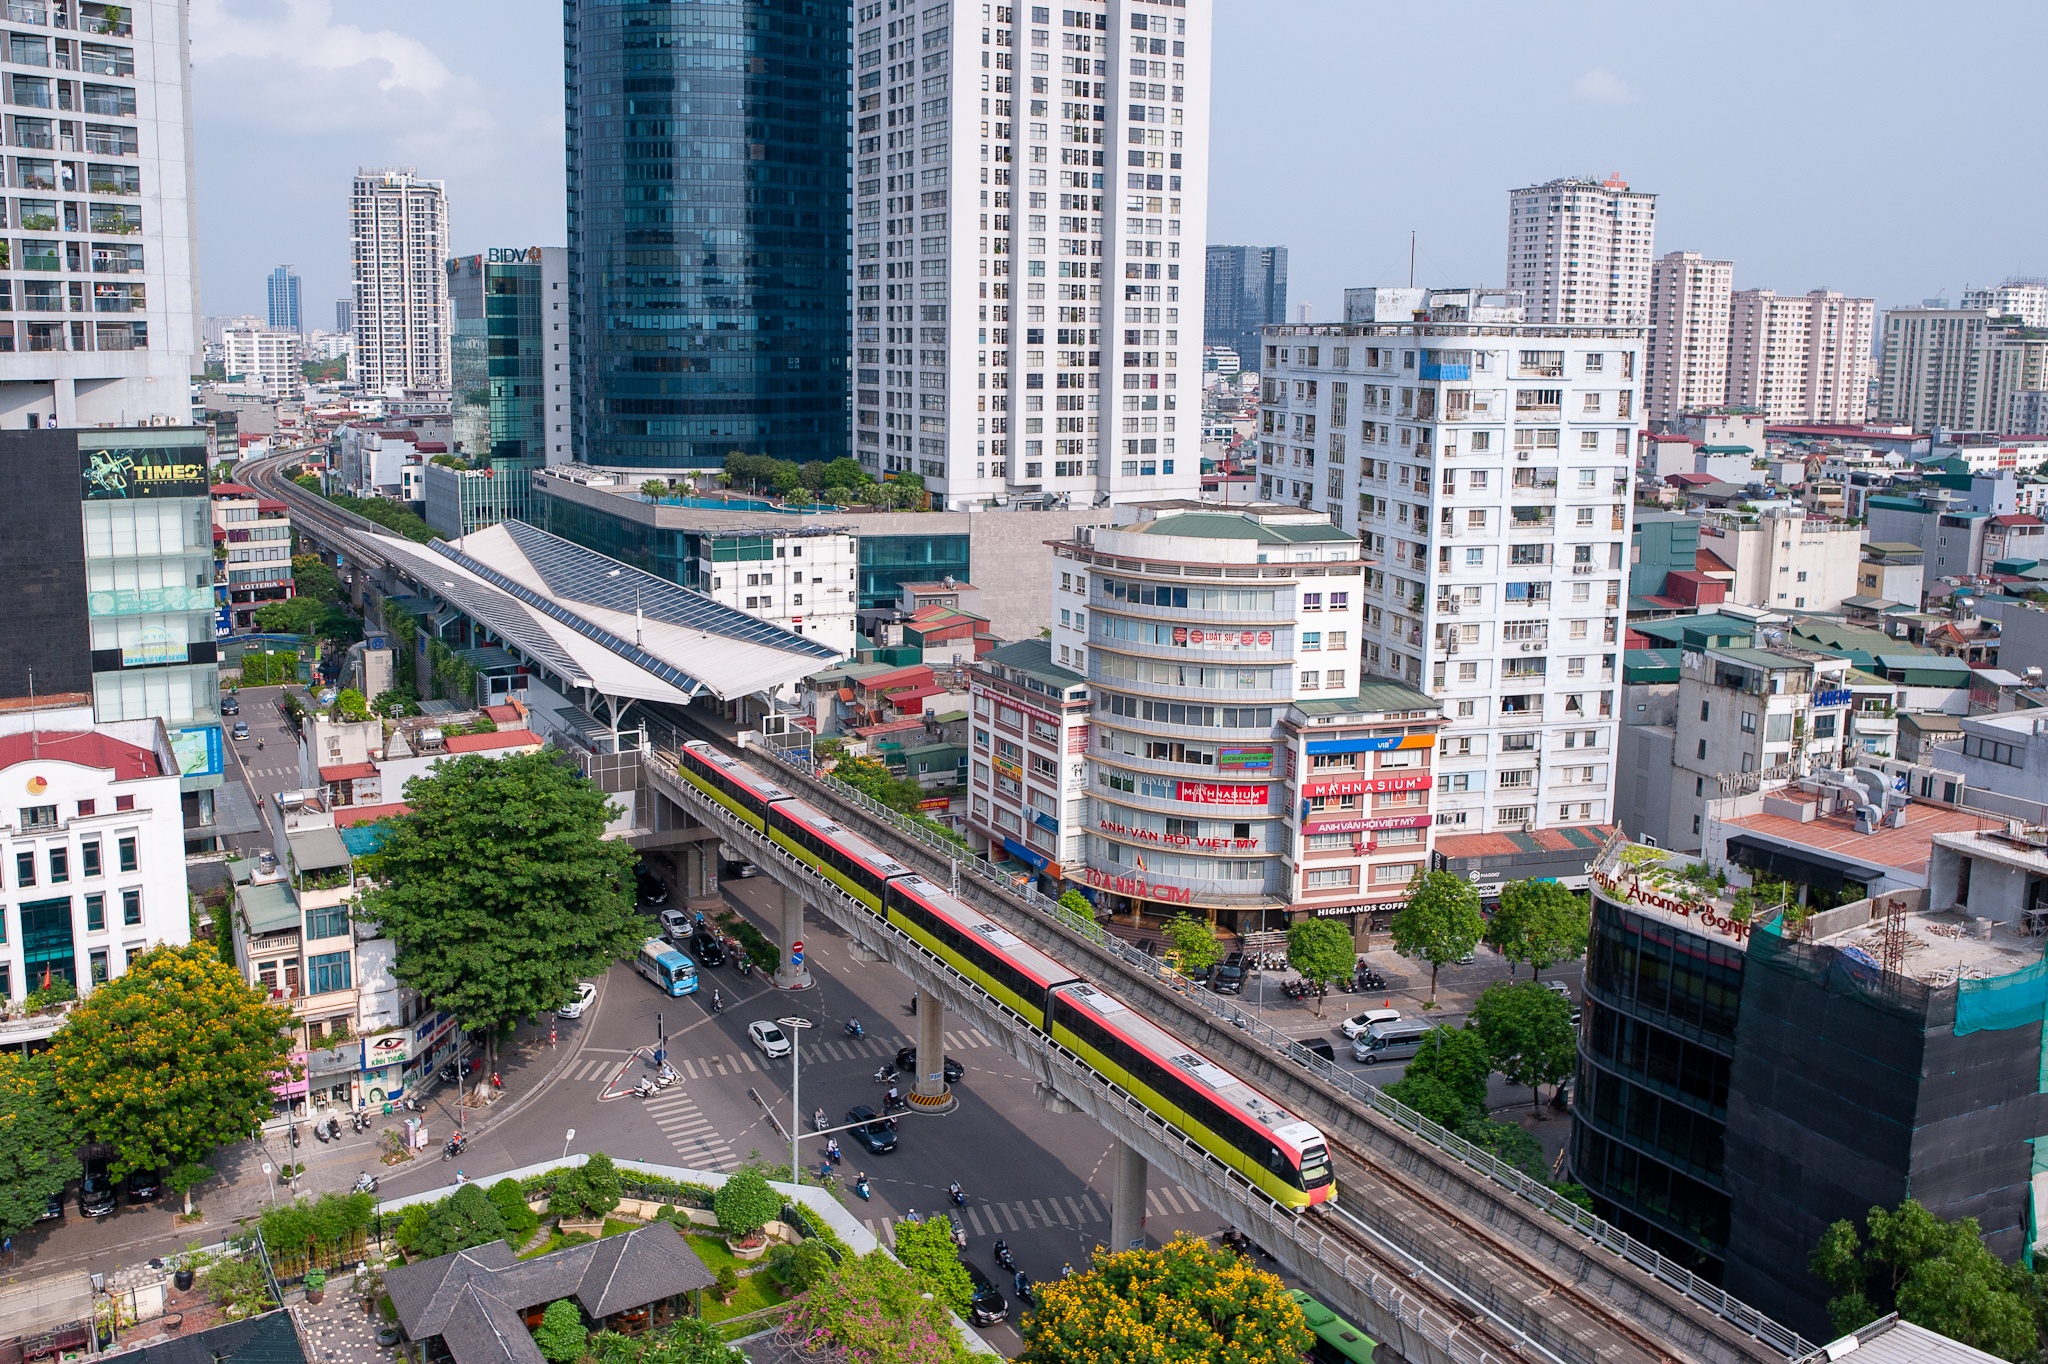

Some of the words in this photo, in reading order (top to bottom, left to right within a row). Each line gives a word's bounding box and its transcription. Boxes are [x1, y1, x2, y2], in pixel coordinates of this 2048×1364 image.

[488, 248, 528, 262] BIDV
[464, 469, 485, 478] BIC
[241, 582, 277, 590] LOTTERIA
[1099, 766, 1133, 780] DIAMOND
[1141, 776, 1172, 787] DENTAL
[1318, 824, 1340, 832] ANH
[1361, 819, 1378, 829] HỘI
[1379, 817, 1400, 828] VIỆT
[1400, 816, 1416, 826] MỸ
[1100, 820, 1126, 834] ANH
[1130, 827, 1158, 842] VĂN
[1164, 833, 1190, 848] HỘI
[1196, 836, 1231, 850] VIỆT
[1236, 836, 1258, 848] MỸ
[1085, 868, 1112, 890] TÒA
[1116, 876, 1148, 898] NHÀ
[1318, 904, 1376, 916] HIGHLANDS
[371, 1056, 385, 1066] KÍNH
[388, 1052, 406, 1063] THUỐC
